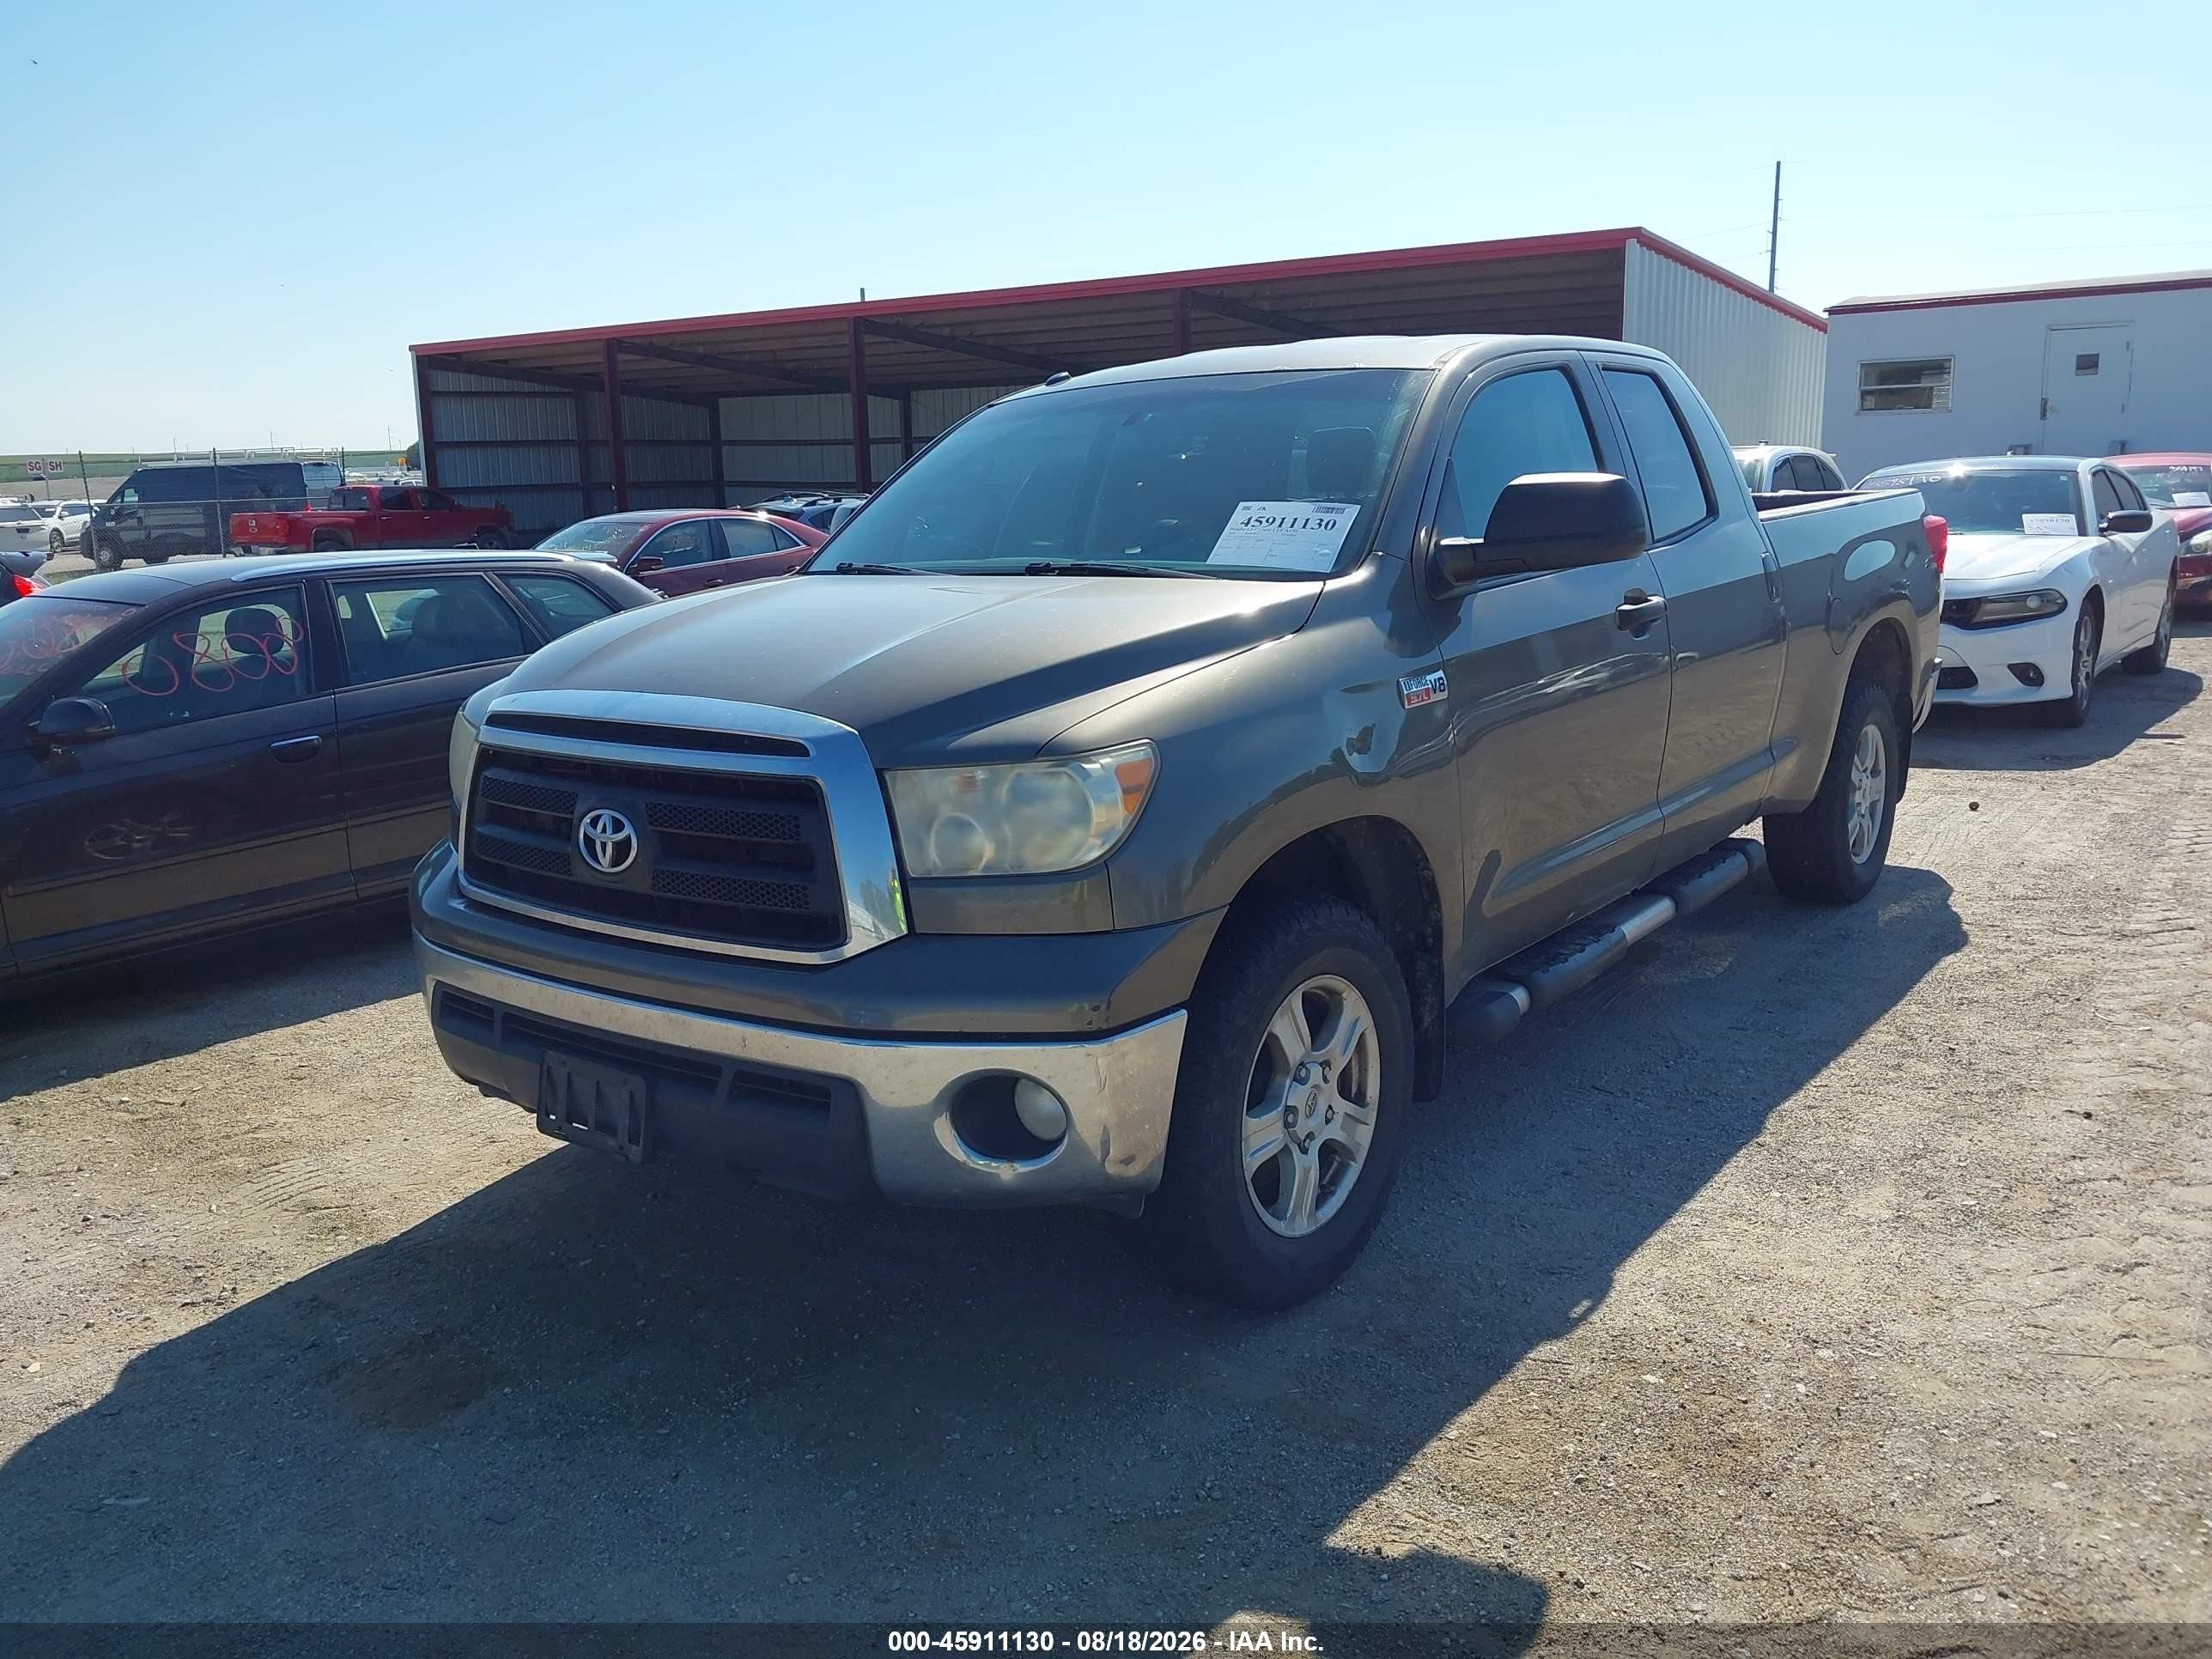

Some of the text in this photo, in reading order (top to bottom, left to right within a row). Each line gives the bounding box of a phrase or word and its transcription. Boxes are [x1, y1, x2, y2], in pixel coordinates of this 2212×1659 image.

[27, 461, 42, 471] SG
[49, 461, 63, 471] SH
[1240, 515, 1337, 532] 45911130
[1429, 676, 1446, 695] V8
